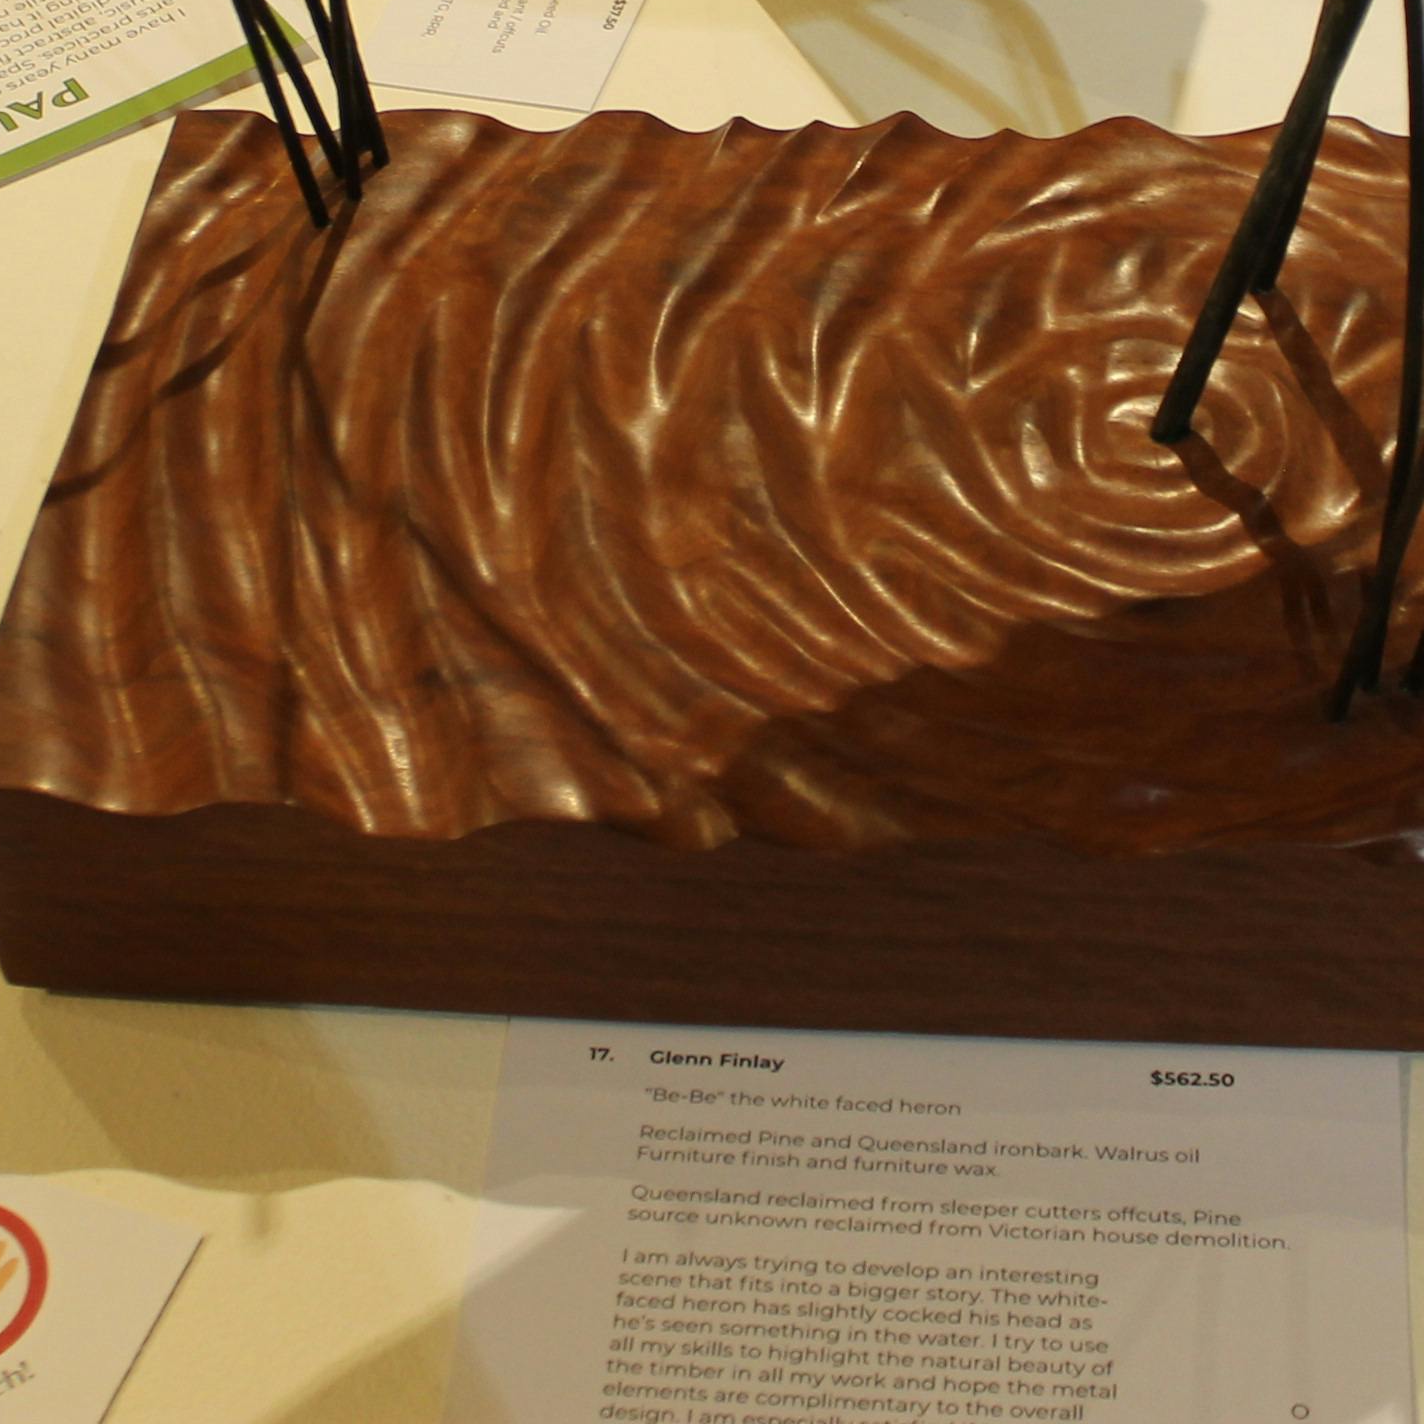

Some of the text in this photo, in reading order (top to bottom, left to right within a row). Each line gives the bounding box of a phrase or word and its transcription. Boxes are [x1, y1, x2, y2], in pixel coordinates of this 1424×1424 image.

[589, 1047, 785, 1073] 17. Glenn Finlay
[1150, 1069, 1235, 1087] $562.50
[730, 1091, 765, 1106] the
[771, 1094, 829, 1110] white
[836, 1095, 893, 1113] faced
[899, 1099, 962, 1115] heron
[637, 1145, 735, 1165] Furniture
[741, 1151, 800, 1168] finish
[806, 1156, 848, 1170] and
[854, 1156, 948, 1175] furniture
[640, 1124, 752, 1144] Reclaimed
[758, 1130, 805, 1146] Pine
[811, 1135, 852, 1149] and
[858, 1135, 987, 1155] Queensland
[1095, 1146, 1169, 1162] Walrus
[1174, 1148, 1200, 1164] oil
[631, 1184, 761, 1205] Queensland
[767, 1193, 874, 1211] reclaimed
[881, 1196, 934, 1213] from
[940, 1200, 1018, 1218] sleeper
[1025, 1205, 1101, 1221] cutters
[1193, 1209, 1241, 1226] Pine
[628, 1208, 699, 1223] source
[706, 1212, 807, 1229] unknown
[814, 1217, 922, 1235] reclaimed
[929, 1220, 982, 1237] from
[989, 1224, 1085, 1241] Victorian
[1092, 1228, 1159, 1245] house
[622, 1247, 1099, 1289] I am always trying to develop an interesting
[619, 1273, 682, 1287] scene
[689, 1274, 732, 1290] that
[739, 1275, 774, 1293] fits
[780, 1281, 823, 1295] into
[828, 1284, 841, 1296] a
[848, 1282, 919, 1302] bigger
[991, 1288, 1031, 1305] The
[616, 1291, 1093, 1330] faced heron has slightly cocked his head as
[612, 1314, 655, 1331] he's
[662, 1320, 713, 1333] seen
[720, 1323, 840, 1344] something
[847, 1329, 868, 1342] in
[874, 1328, 911, 1344] the
[992, 1333, 998, 1348] I
[1004, 1335, 1035, 1353] try
[1041, 1337, 1063, 1352] to
[1070, 1340, 1109, 1353] use
[609, 1336, 1114, 1378] all my skills to highlight the natural beauty of
[606, 1359, 1117, 1399] the timber in all my work and hope the metal
[602, 1382, 1084, 1418] elements are complimentary to the overall
